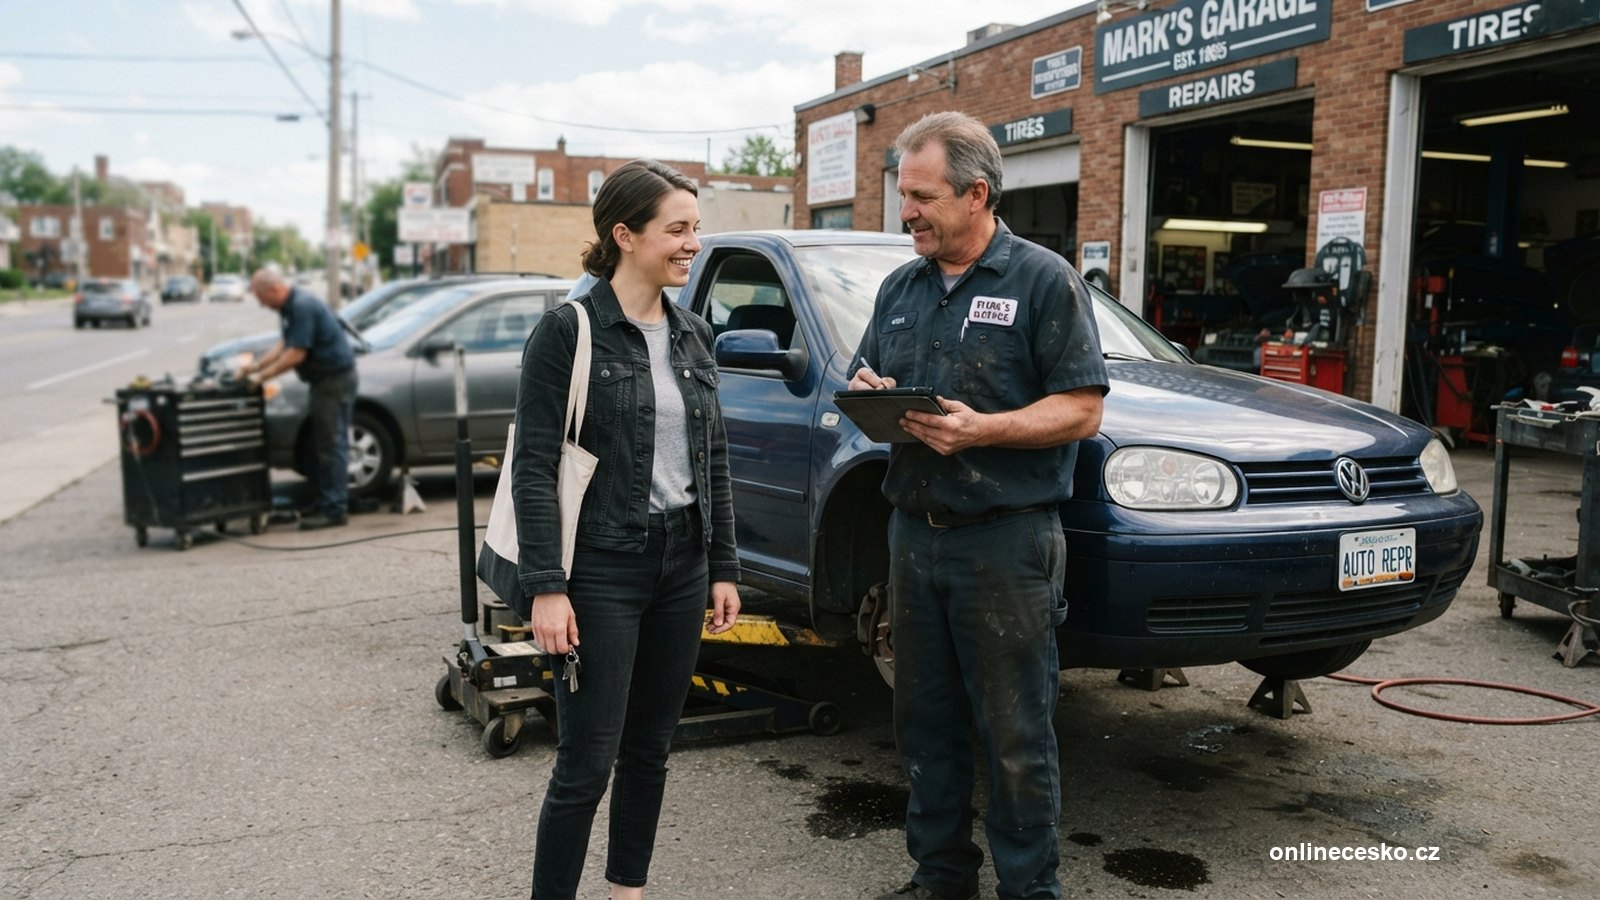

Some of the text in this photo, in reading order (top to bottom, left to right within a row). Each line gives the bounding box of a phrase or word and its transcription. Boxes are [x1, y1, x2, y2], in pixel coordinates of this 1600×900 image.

[1103, 7, 1193, 67] MARK'S
[1173, 49, 1197, 71] EST.
[1169, 70, 1255, 108] REPAIRS
[1004, 116, 1044, 142] TIRES
[1343, 545, 1413, 577] AUTO REPR
